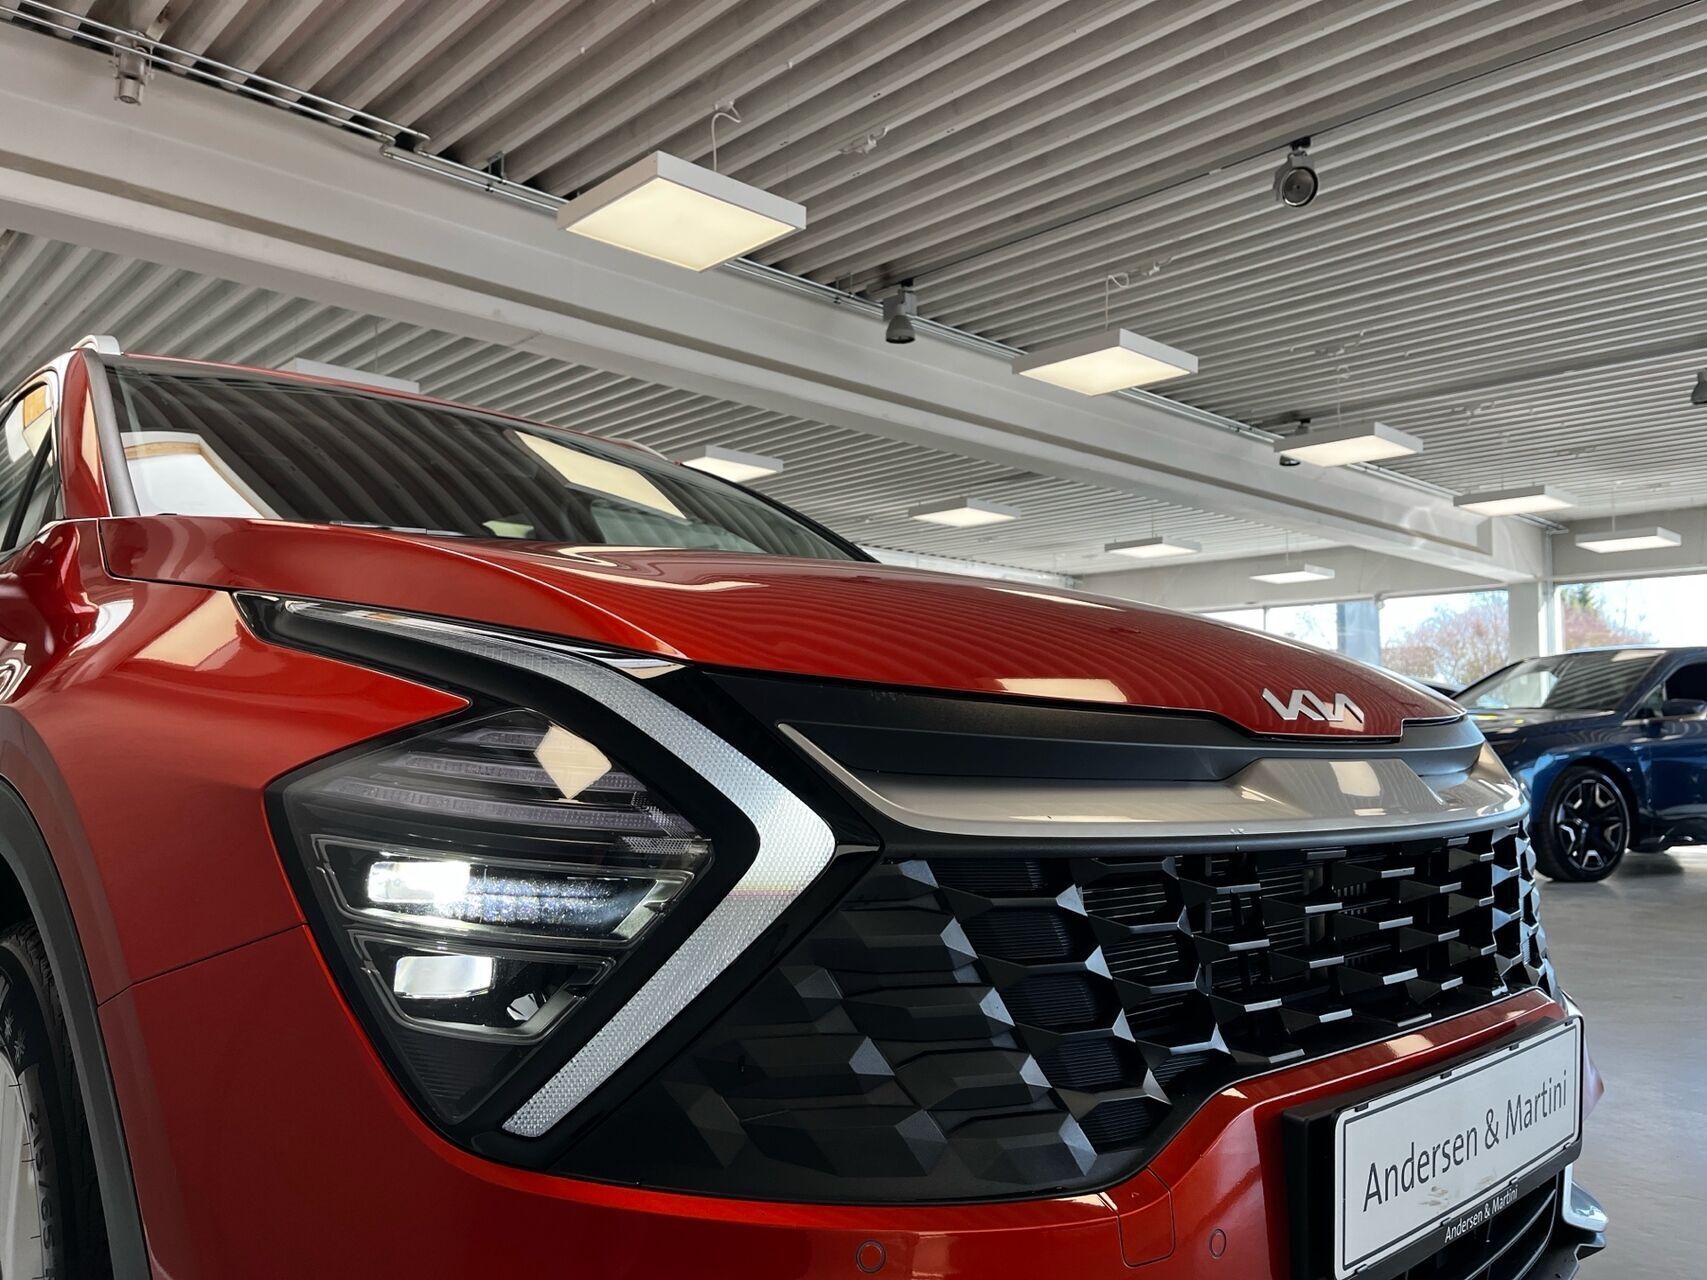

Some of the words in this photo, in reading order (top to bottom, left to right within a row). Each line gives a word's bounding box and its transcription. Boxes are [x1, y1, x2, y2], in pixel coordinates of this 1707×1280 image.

[1362, 1141, 1478, 1212] Andersen
[1484, 1108, 1500, 1150] &
[1505, 1070, 1567, 1139] Martini
[1444, 1210, 1483, 1243] Andersen
[1484, 1202, 1491, 1219] &
[1491, 1184, 1518, 1214] Martini
